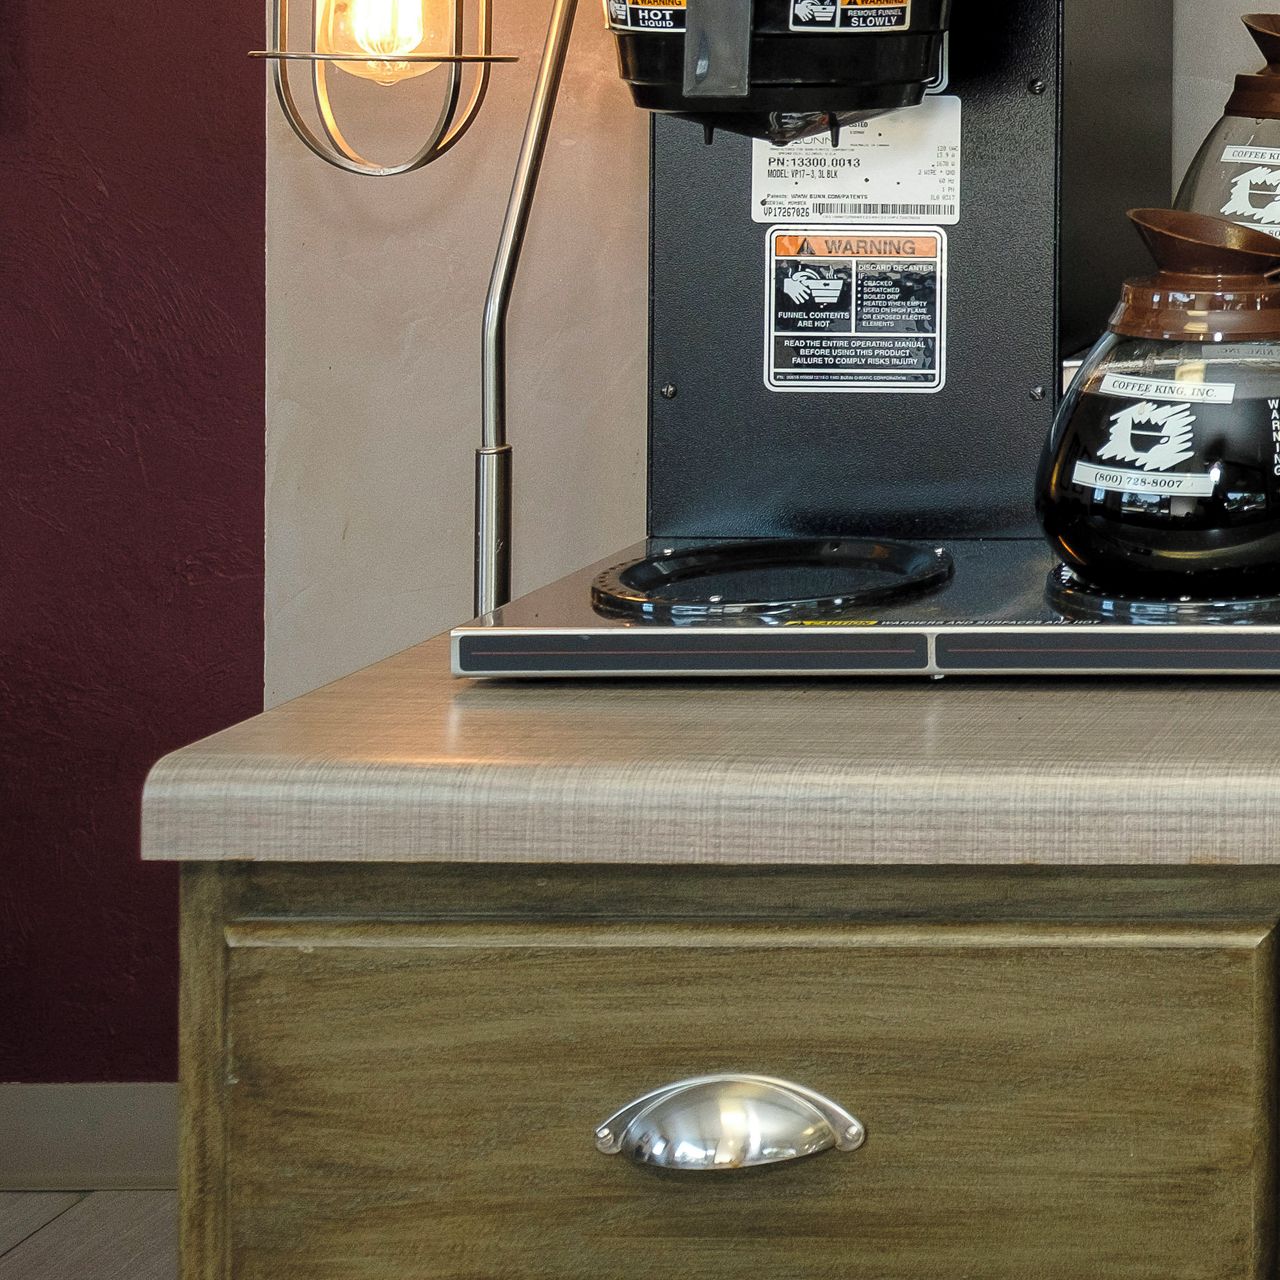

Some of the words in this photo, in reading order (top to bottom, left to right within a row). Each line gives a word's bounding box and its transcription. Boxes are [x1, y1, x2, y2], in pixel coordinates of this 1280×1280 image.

[638, 9, 673, 20] HOT
[639, 20, 674, 28] LIQUID
[851, 16, 897, 26] SLOWLY
[1232, 150, 1267, 160] COFFEE
[767, 170, 790, 178] MODEL:
[826, 170, 838, 178] BLK
[825, 240, 916, 255] WARNING
[1112, 380, 1152, 393] COFFEE
[1191, 386, 1217, 398] INC.
[1094, 472, 1123, 486] (800)
[1125, 477, 1183, 489] 728-8007
